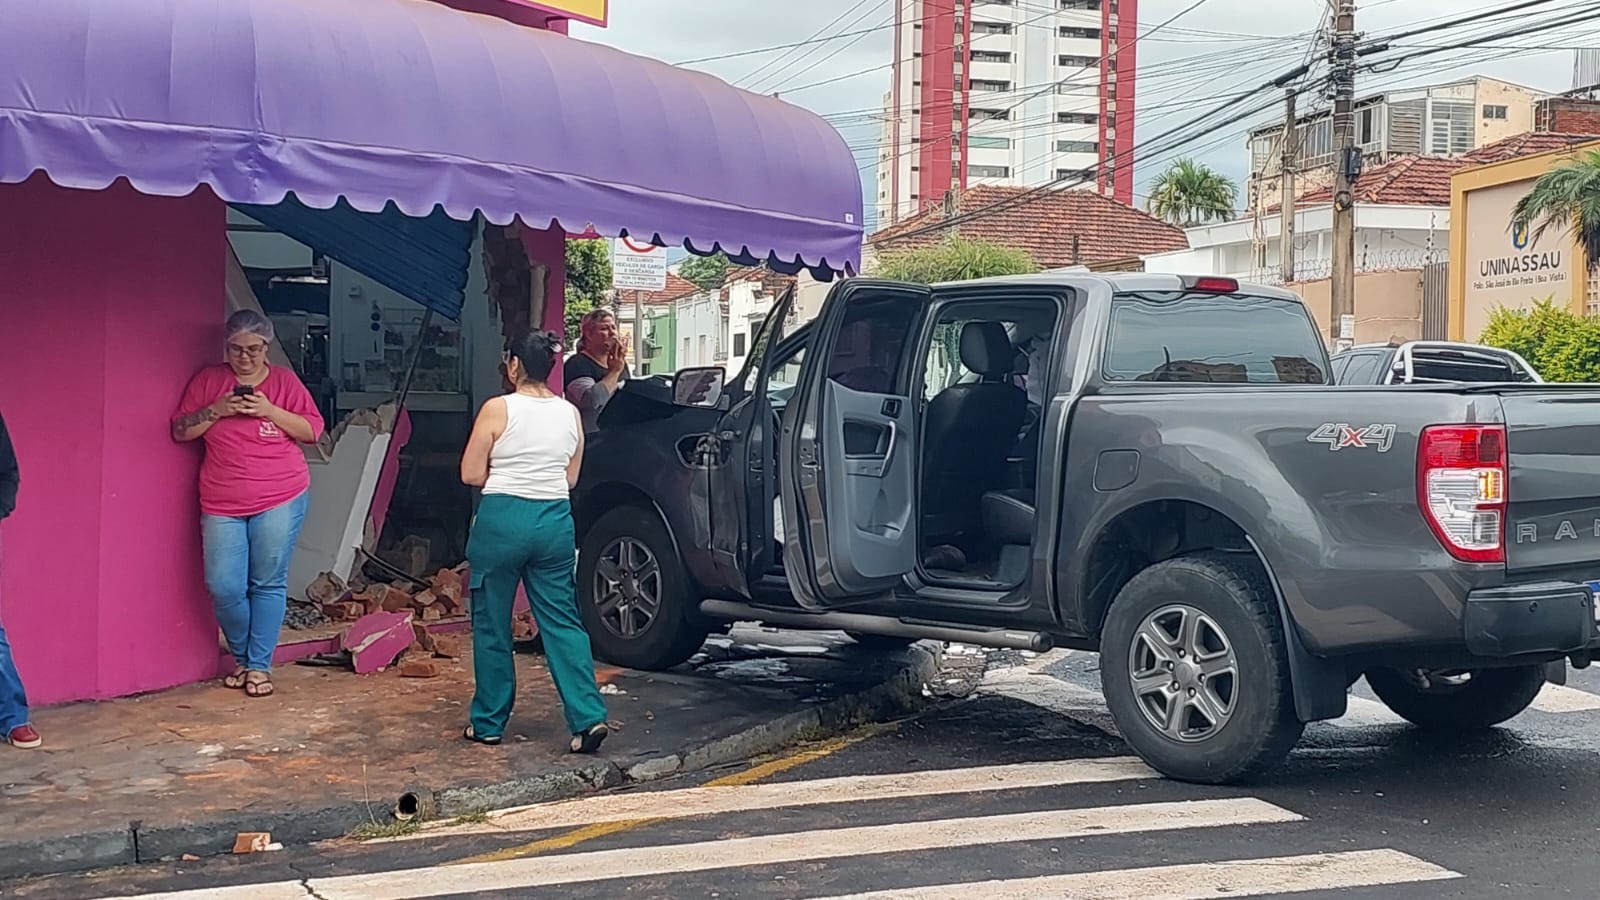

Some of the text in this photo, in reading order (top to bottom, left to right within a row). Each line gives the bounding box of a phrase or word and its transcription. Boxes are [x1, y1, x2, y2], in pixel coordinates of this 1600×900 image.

[1480, 250, 1561, 276] UNINASSAU
[1512, 277, 1520, 286] Rio
[1520, 276, 1534, 285] Preto
[1535, 274, 1547, 283] (Boa
[1549, 271, 1568, 281] Vista)
